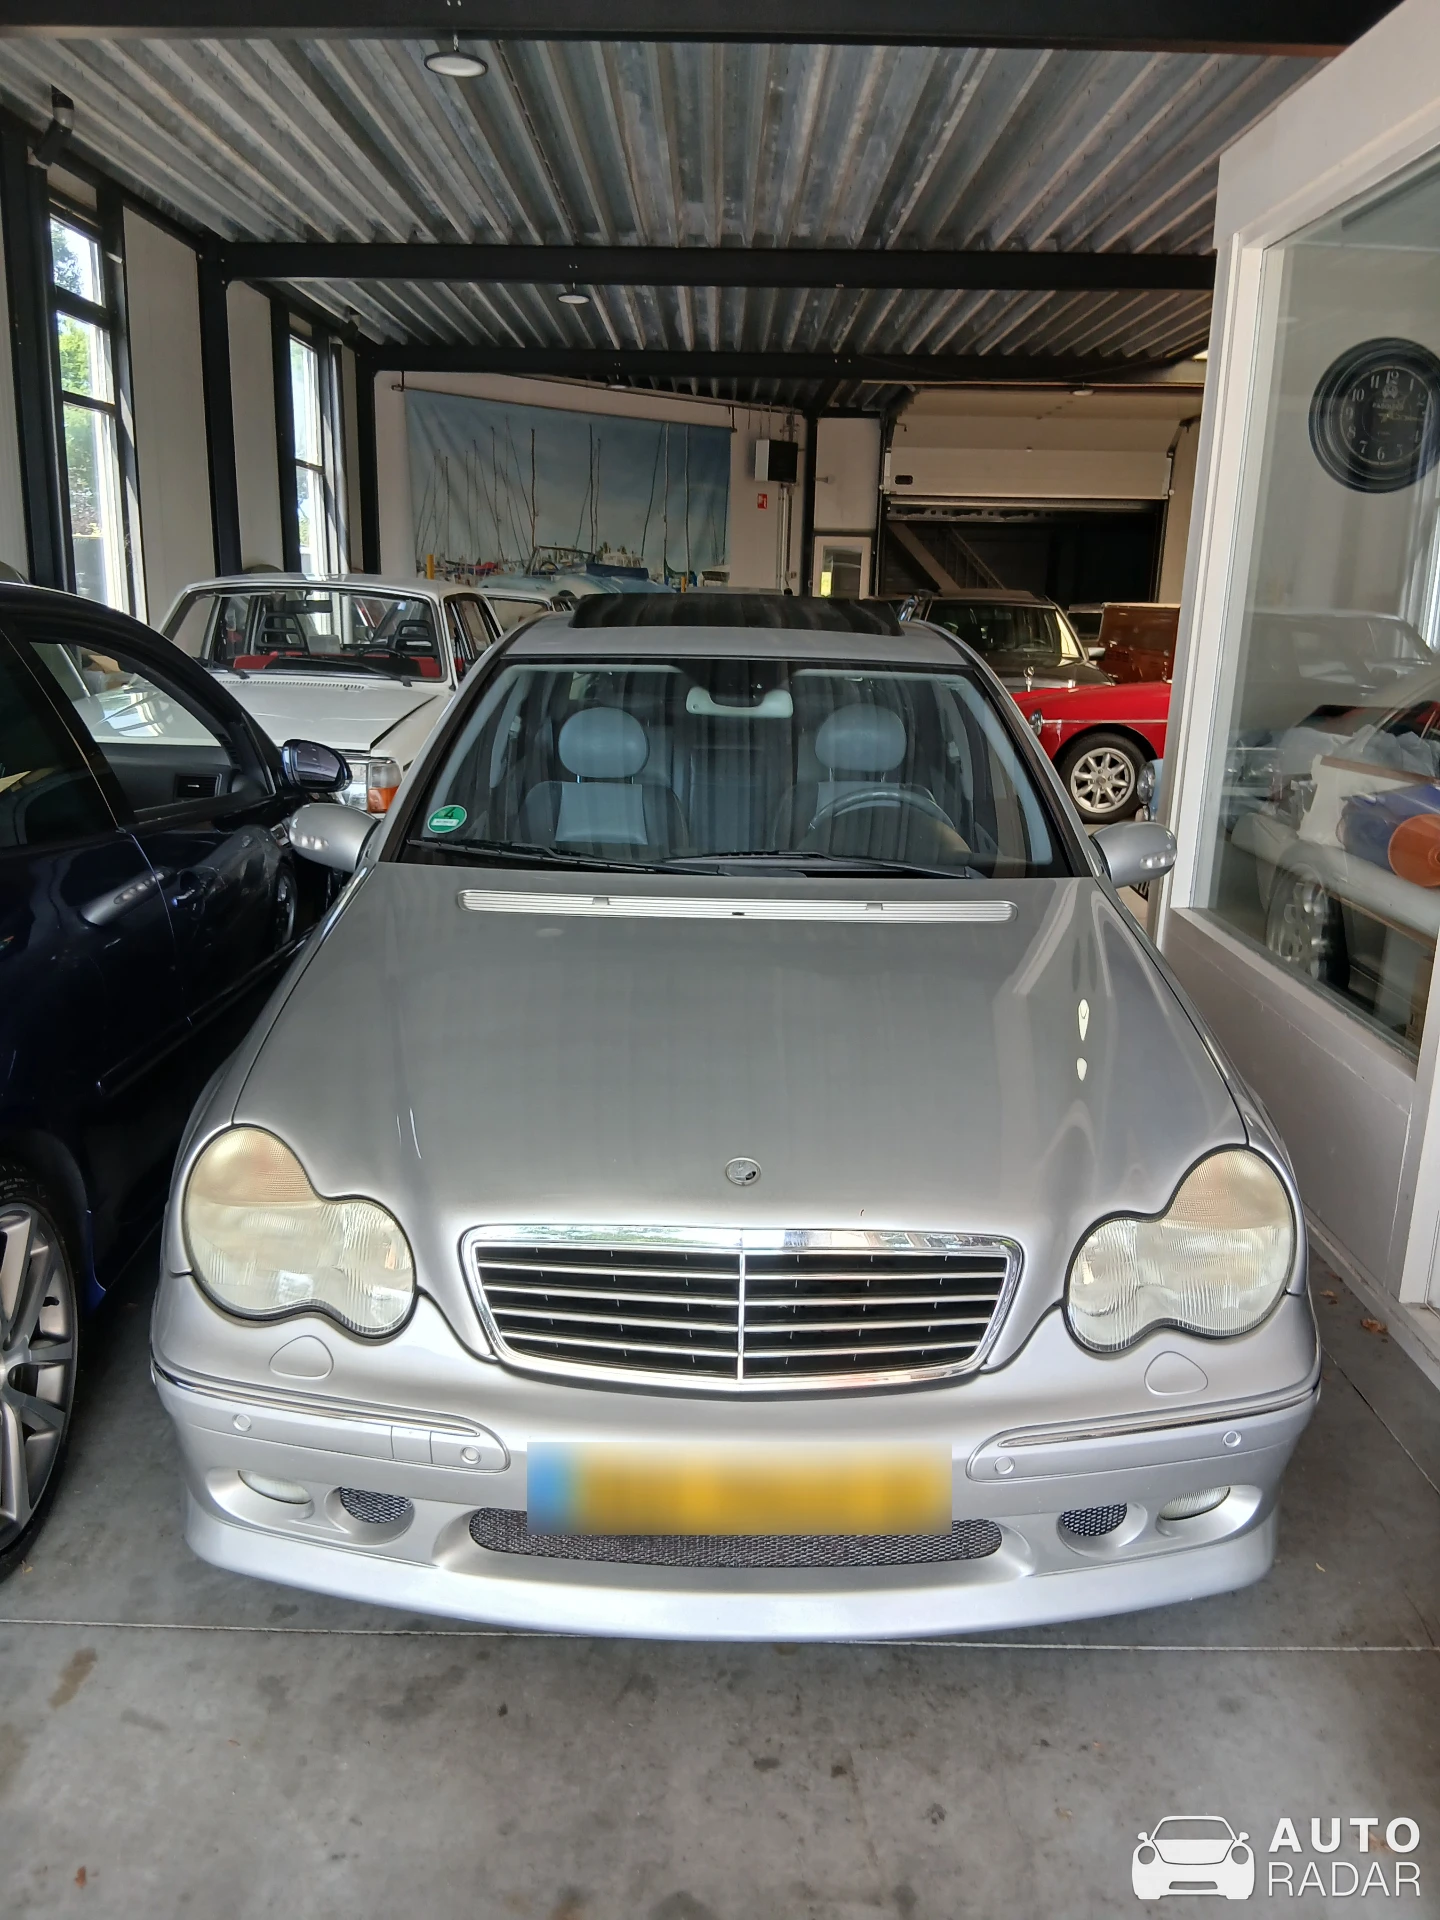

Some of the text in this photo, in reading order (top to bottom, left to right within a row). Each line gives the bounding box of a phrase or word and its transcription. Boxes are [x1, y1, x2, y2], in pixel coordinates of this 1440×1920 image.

[1370, 375, 1380, 389] 11
[1386, 371, 1399, 385] 12
[1352, 389, 1365, 402] 10
[1345, 407, 1354, 420] 9
[1347, 425, 1356, 439] 8
[1360, 440, 1368, 454] 7
[1377, 447, 1385, 460] 6
[444, 807, 456, 819] 4
